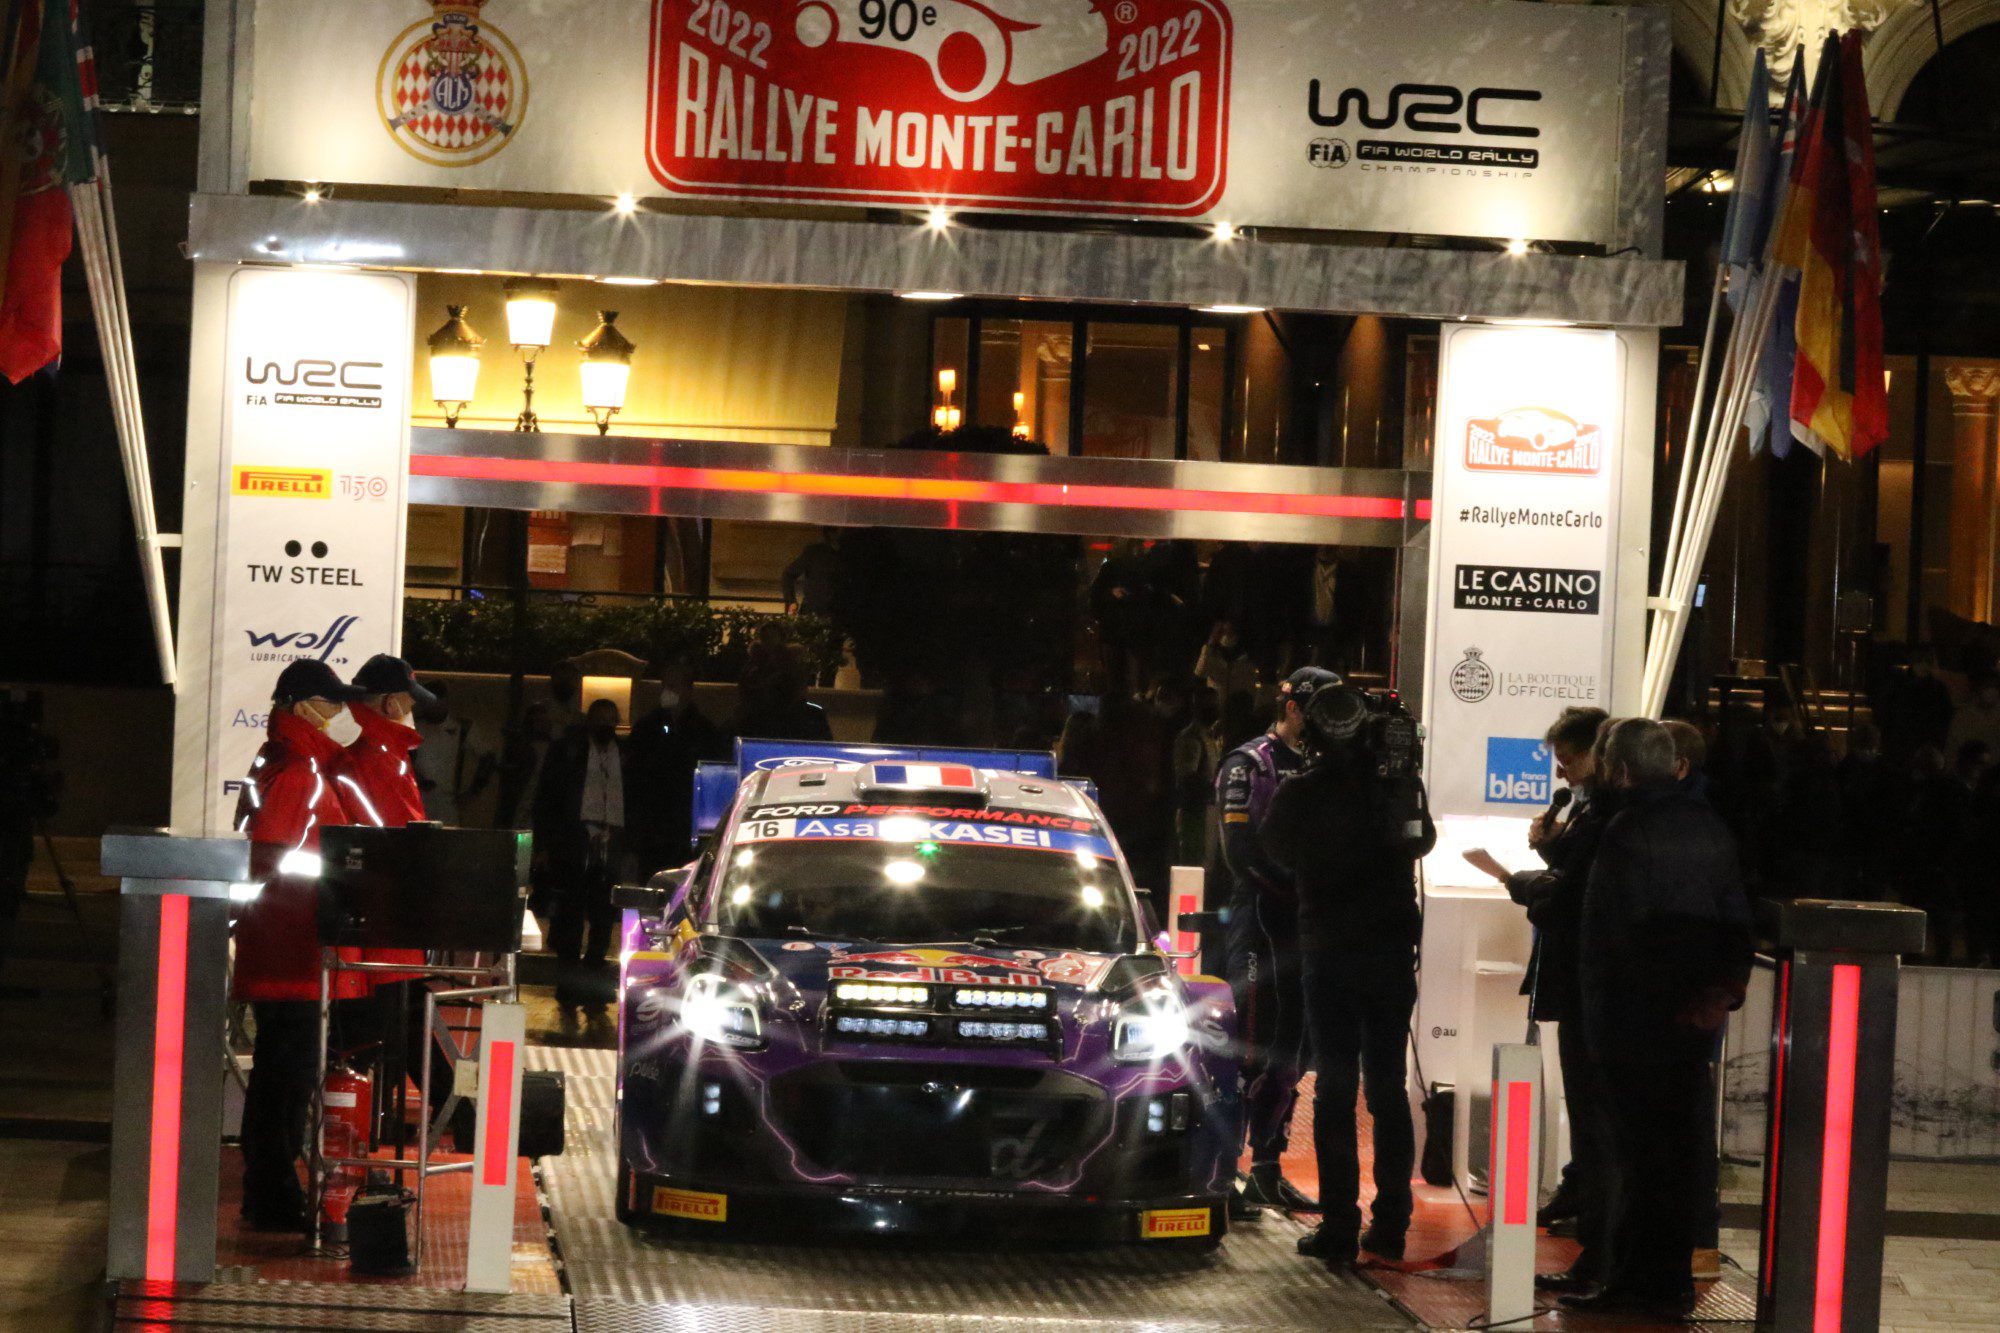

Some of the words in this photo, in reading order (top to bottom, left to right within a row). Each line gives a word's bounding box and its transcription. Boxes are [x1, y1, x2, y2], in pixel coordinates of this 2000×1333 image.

[686, 0, 772, 69] 2022
[1116, 9, 1202, 82] 2022
[675, 41, 838, 165] RALLYE
[855, 70, 1201, 181] MONTE-CARLO
[1308, 78, 1542, 138] WRC
[1394, 148, 1463, 160] WORLD
[1468, 150, 1535, 163] RALLY
[1360, 163, 1533, 179] CHAMPIONSHIP
[246, 356, 383, 390] WRC
[1469, 434, 1510, 467] RALLYE
[240, 471, 324, 493] PIRELLI
[1459, 506, 1602, 528] #RallyeMonteCarlo
[247, 565, 283, 583] TW
[290, 566, 363, 586] STEEL
[1458, 570, 1485, 590] LE
[1490, 571, 1597, 595] CASINO
[1508, 672, 1525, 683] LA
[1529, 673, 1597, 688] BOUTIQUE
[1507, 685, 1596, 700] OFFICIELLE
[1489, 773, 1547, 801] bleu
[1521, 771, 1548, 781] france
[747, 820, 780, 838] 16
[752, 805, 841, 818] FORD
[843, 804, 1094, 831] PERFORMANCE
[656, 1192, 722, 1217] PIRELLI
[1148, 1213, 1207, 1233] PIRELLI
